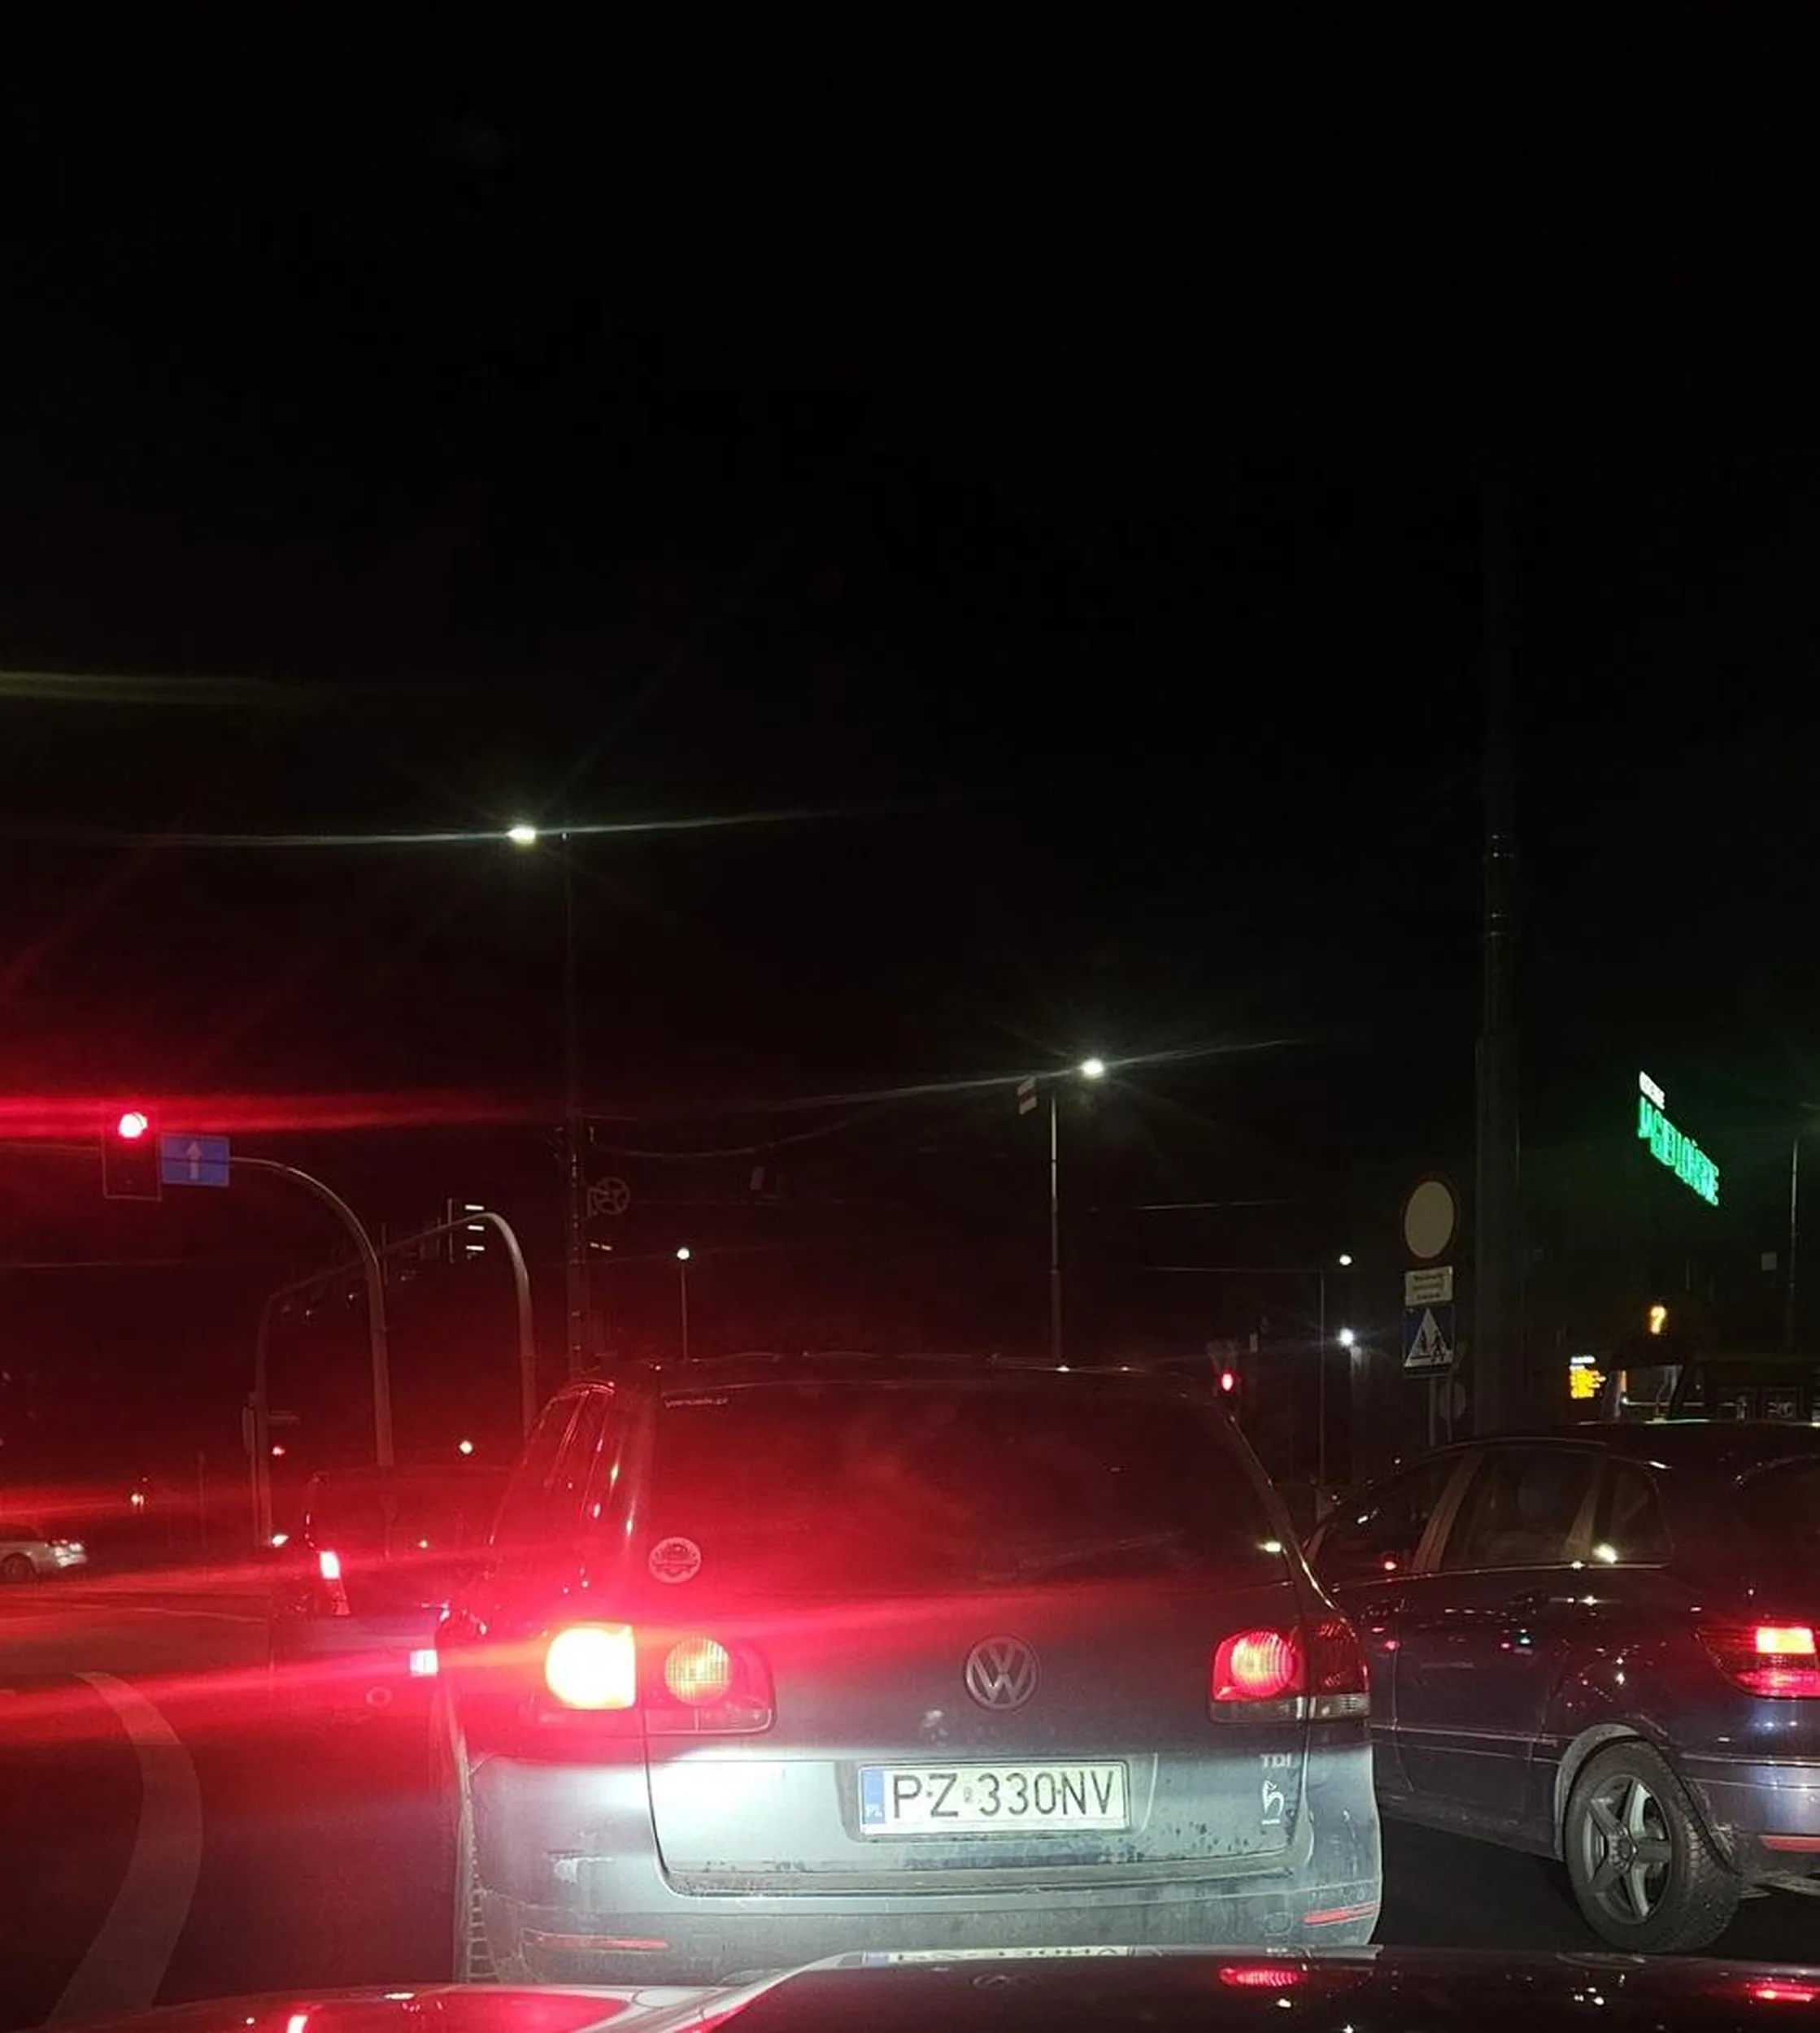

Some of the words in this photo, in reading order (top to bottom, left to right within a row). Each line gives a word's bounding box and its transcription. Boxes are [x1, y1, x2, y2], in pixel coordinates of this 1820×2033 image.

[1260, 1752, 1291, 1768] TDI
[893, 1772, 959, 1819] PZ
[977, 1770, 1113, 1816] 330NV
